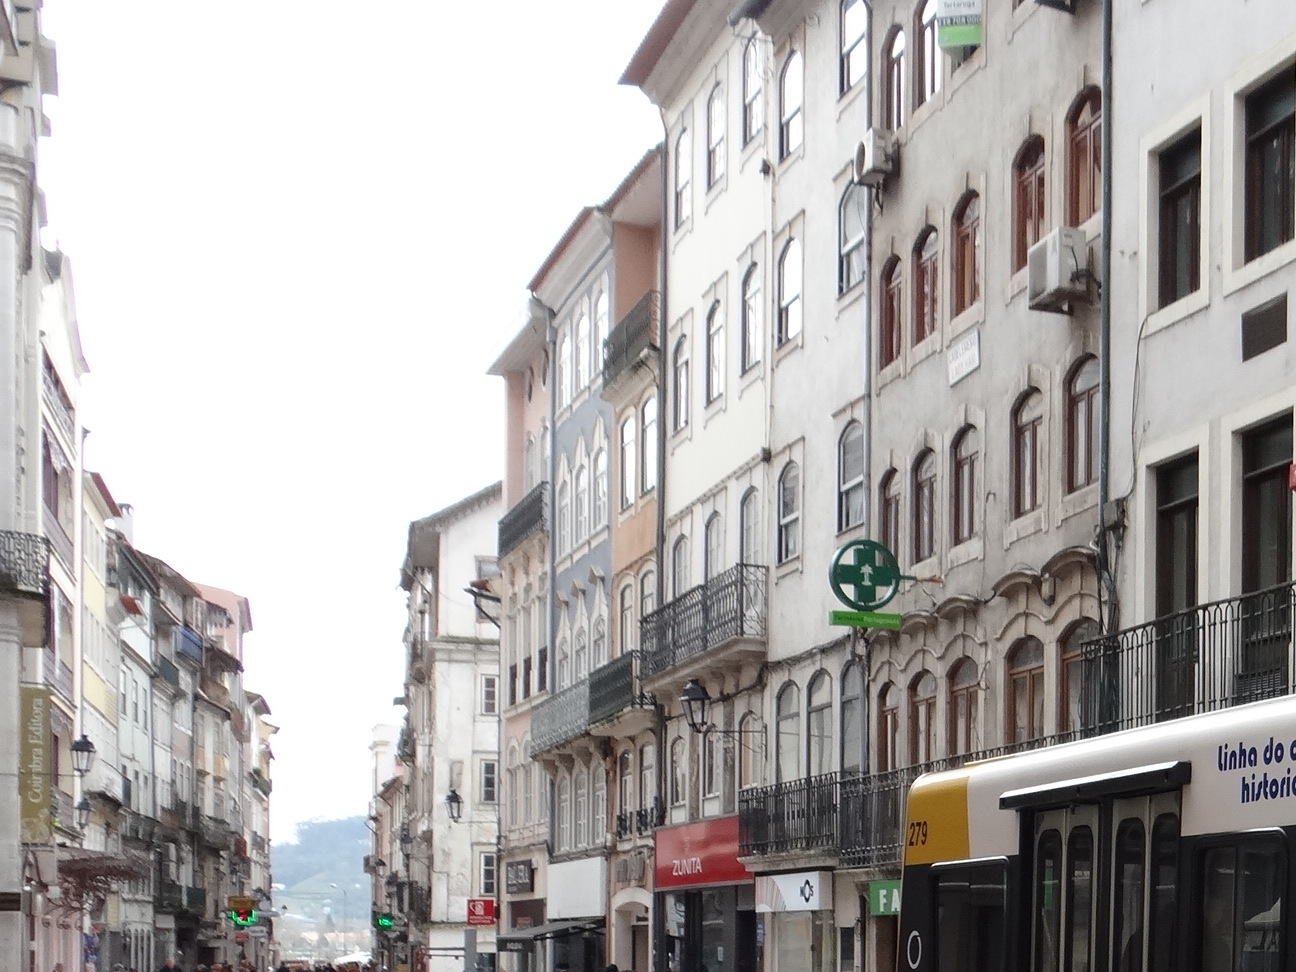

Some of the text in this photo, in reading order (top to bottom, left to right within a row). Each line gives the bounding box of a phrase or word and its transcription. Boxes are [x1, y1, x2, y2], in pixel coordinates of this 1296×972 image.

[28, 698, 43, 744] Editora
[1263, 737, 1285, 766] do
[908, 820, 928, 847] 279
[672, 857, 703, 876] ZUNITA
